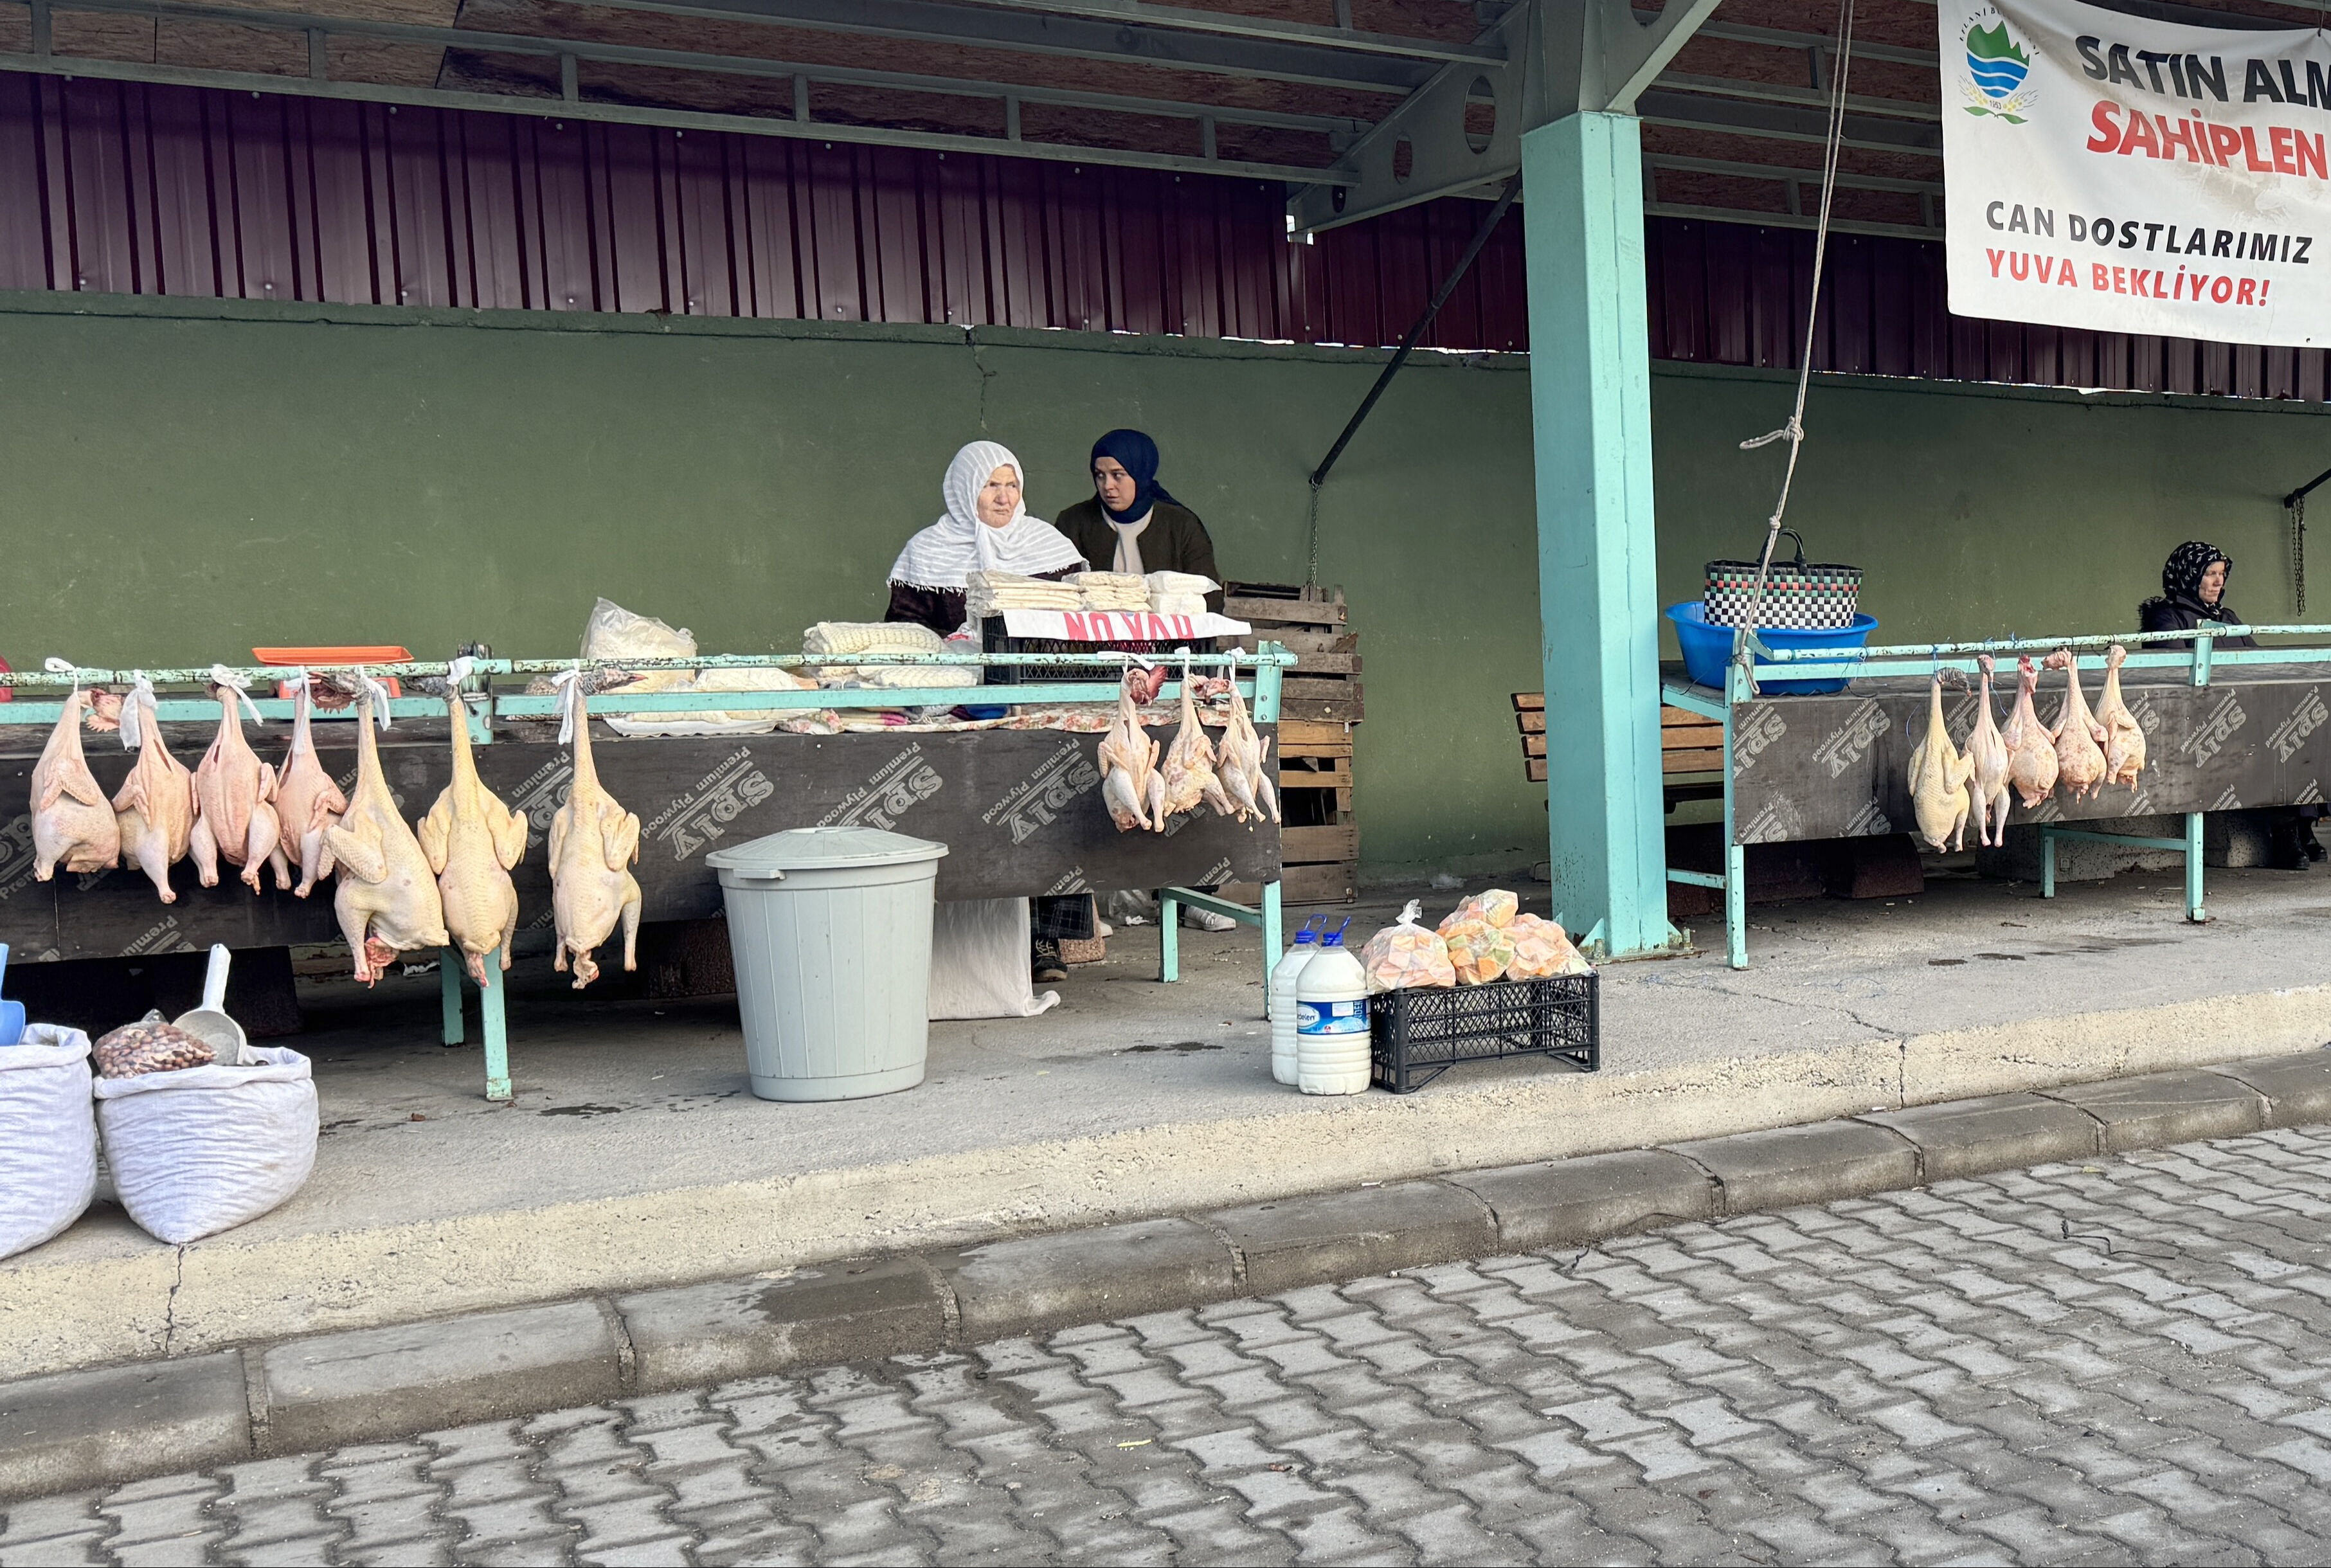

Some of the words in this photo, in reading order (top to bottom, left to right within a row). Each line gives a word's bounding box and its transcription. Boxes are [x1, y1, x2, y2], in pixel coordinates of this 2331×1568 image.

[2075, 35, 2229, 102] SATIN
[2087, 100, 2329, 180] SAHİPLEN
[1986, 201, 2055, 239] CAN
[2068, 213, 2314, 264] DOSTLARIMIZ
[1986, 248, 2078, 288] YUVA
[2092, 262, 2271, 307] BEKLİYOR!
[2208, 688, 2236, 720] Premium
[2292, 685, 2319, 716] Premium
[1812, 726, 1844, 762] Plywood
[1830, 709, 1891, 779] Sply
[2180, 721, 2208, 753] Plywood
[2195, 705, 2247, 769] Sply
[2265, 717, 2292, 748] Plywood
[2280, 701, 2329, 764] Sply
[512, 751, 571, 798] Premium
[696, 746, 752, 791] Premium
[869, 742, 921, 786] Premium
[1030, 738, 1081, 780] Premium
[641, 793, 694, 839] Plywood
[672, 770, 775, 861] Sply
[843, 765, 943, 831] Spl
[982, 781, 1030, 824] Plywood
[1009, 760, 1101, 845] Sply
[1740, 801, 1778, 838] Premium
[1846, 795, 1879, 831] Premium
